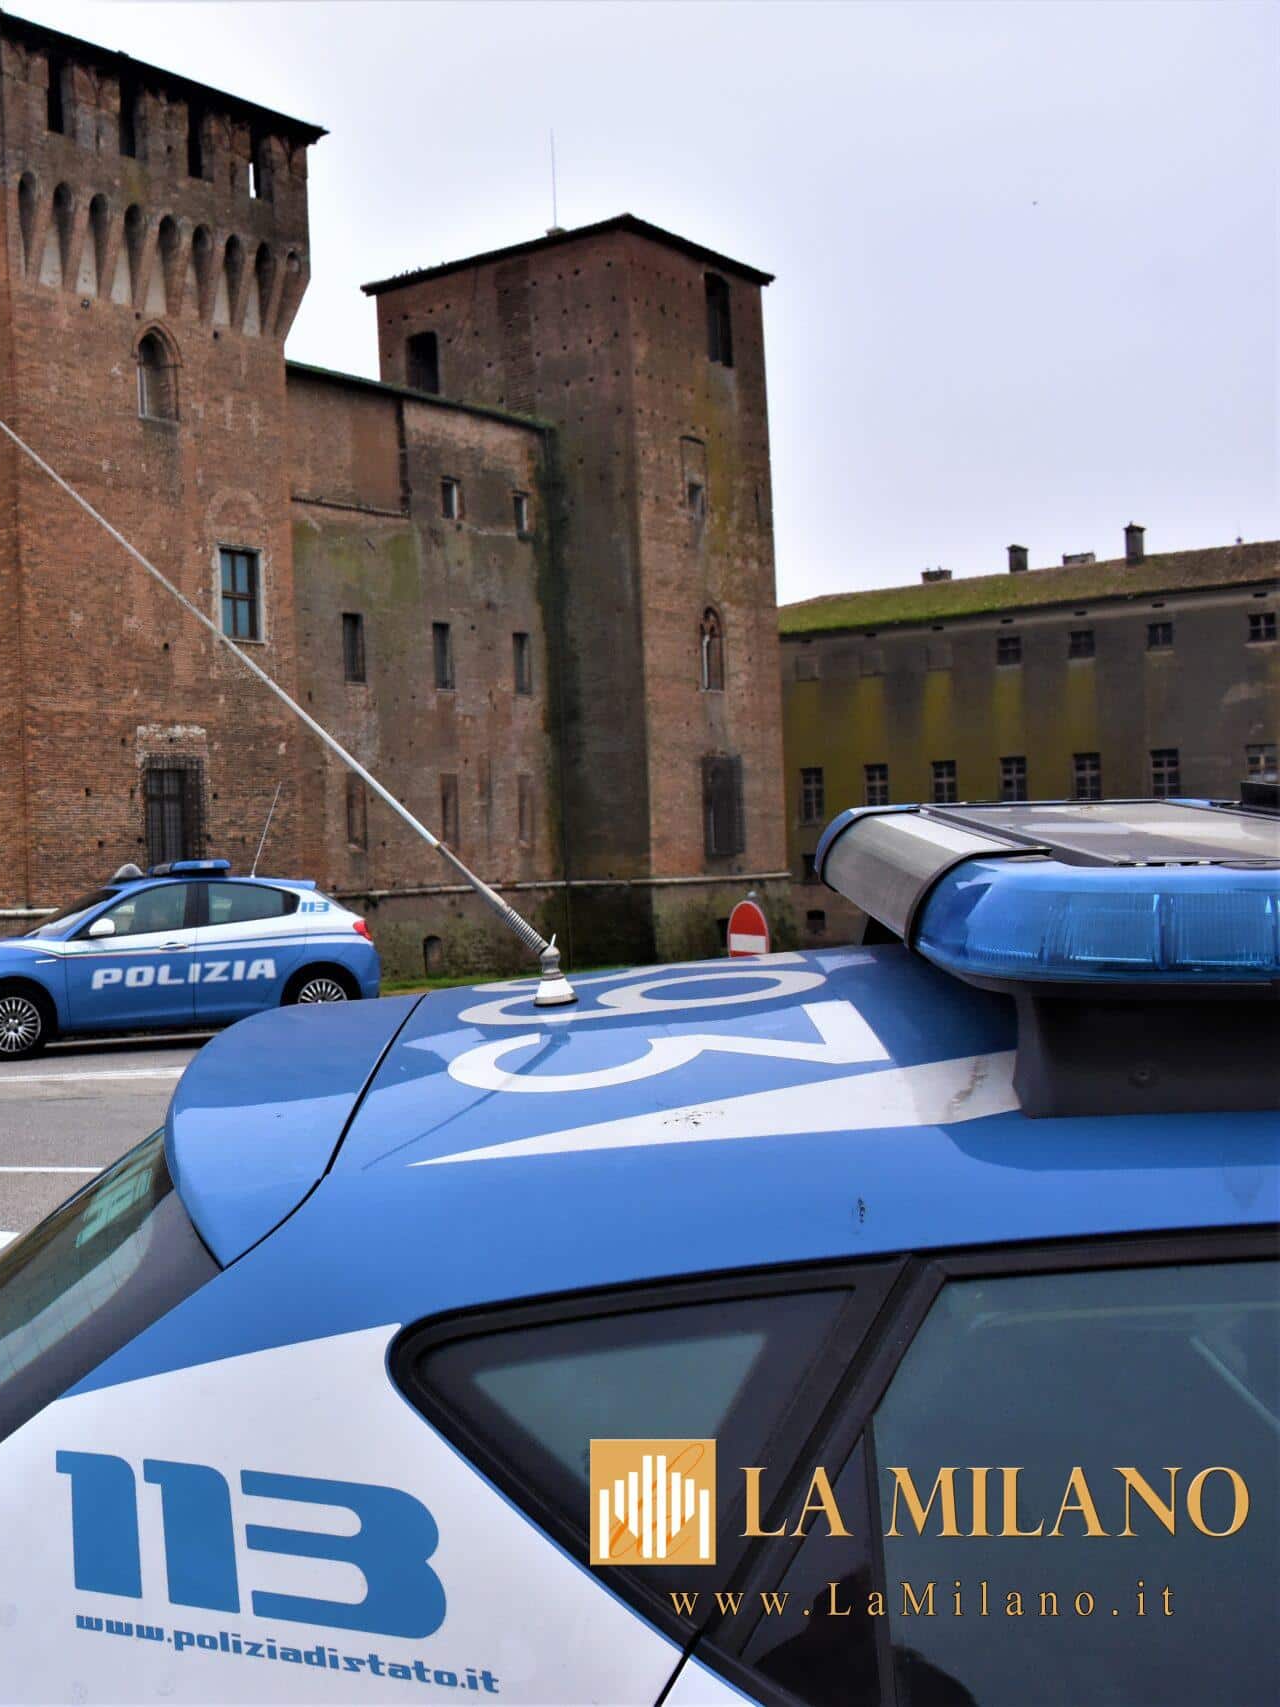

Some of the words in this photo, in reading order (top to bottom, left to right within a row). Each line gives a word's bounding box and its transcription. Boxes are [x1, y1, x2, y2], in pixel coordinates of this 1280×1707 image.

[301, 902, 329, 913] 113
[91, 958, 277, 990] POLIZIA
[55, 1449, 447, 1640] 113
[75, 1614, 500, 1694] www.poliziadistato.it
